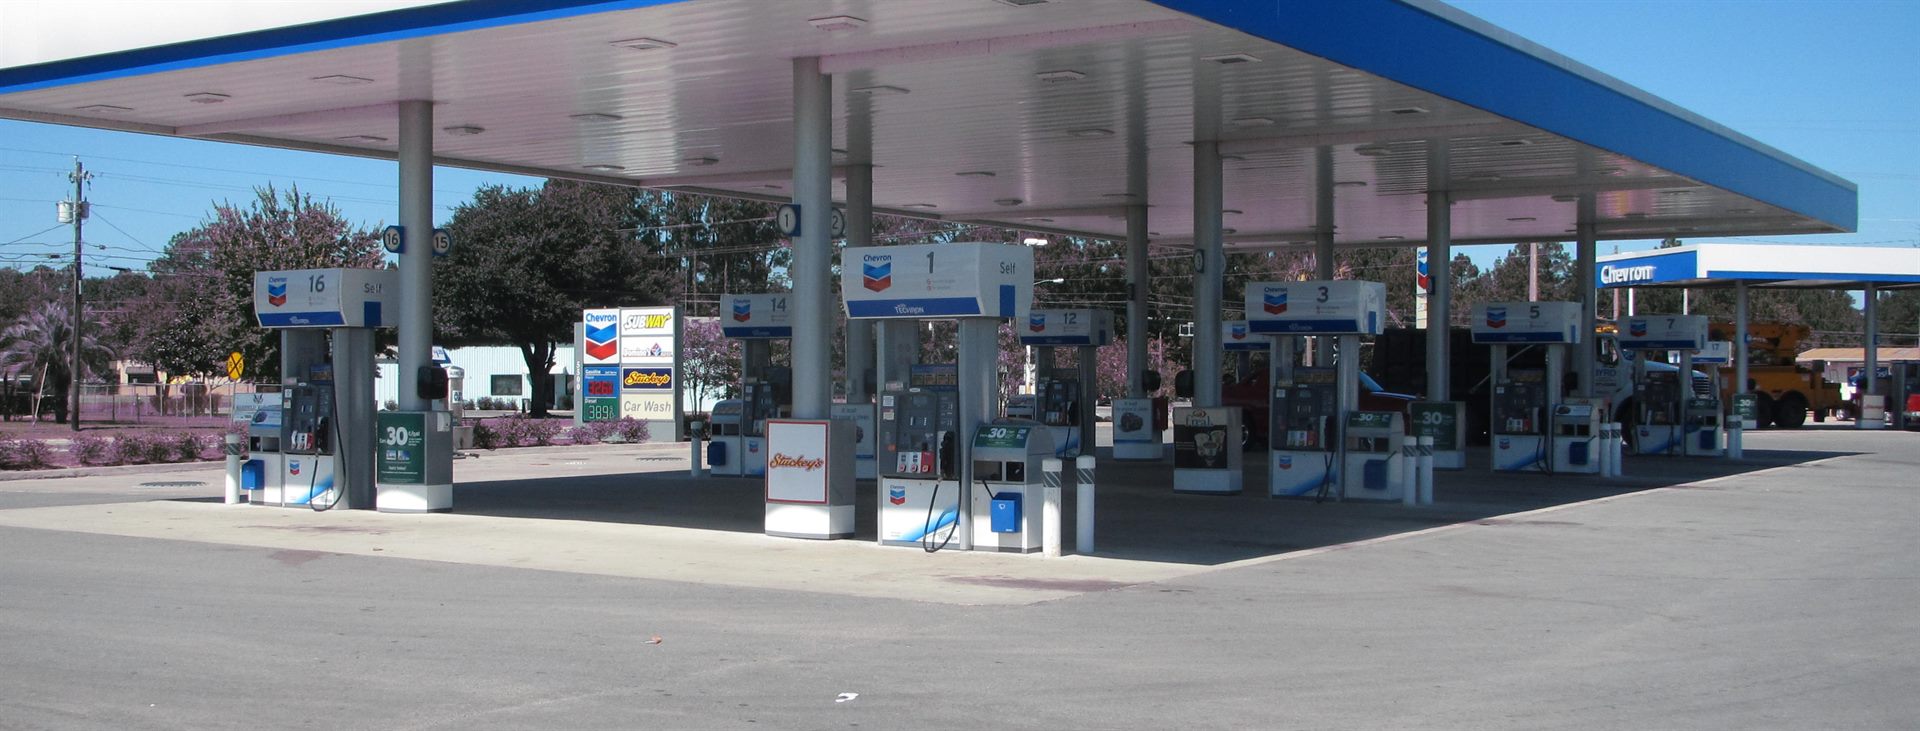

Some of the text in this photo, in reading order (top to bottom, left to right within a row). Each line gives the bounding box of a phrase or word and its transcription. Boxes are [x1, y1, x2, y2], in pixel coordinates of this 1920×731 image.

[832, 215, 839, 230] 2
[387, 233, 399, 246] 16
[435, 236, 448, 249] 15
[863, 254, 892, 262] Chevron
[926, 251, 935, 274] 1
[1000, 262, 1016, 275] Self
[1601, 265, 1653, 284] Chevron
[308, 275, 325, 293] 16
[364, 283, 382, 294] Self
[1316, 286, 1329, 303] 3
[770, 297, 787, 313] 14
[1529, 305, 1540, 319] 5
[585, 312, 618, 323] Chevron
[623, 312, 672, 331] SUBWAY
[1063, 312, 1078, 325] 12
[1666, 318, 1675, 329] 7
[624, 370, 671, 387] Stuckey's
[623, 400, 641, 412] Car
[644, 400, 672, 413] Wash
[1422, 411, 1442, 425] 30
[386, 426, 408, 446] 30
[988, 428, 1006, 438] 30
[770, 453, 824, 471] Stuckey's
